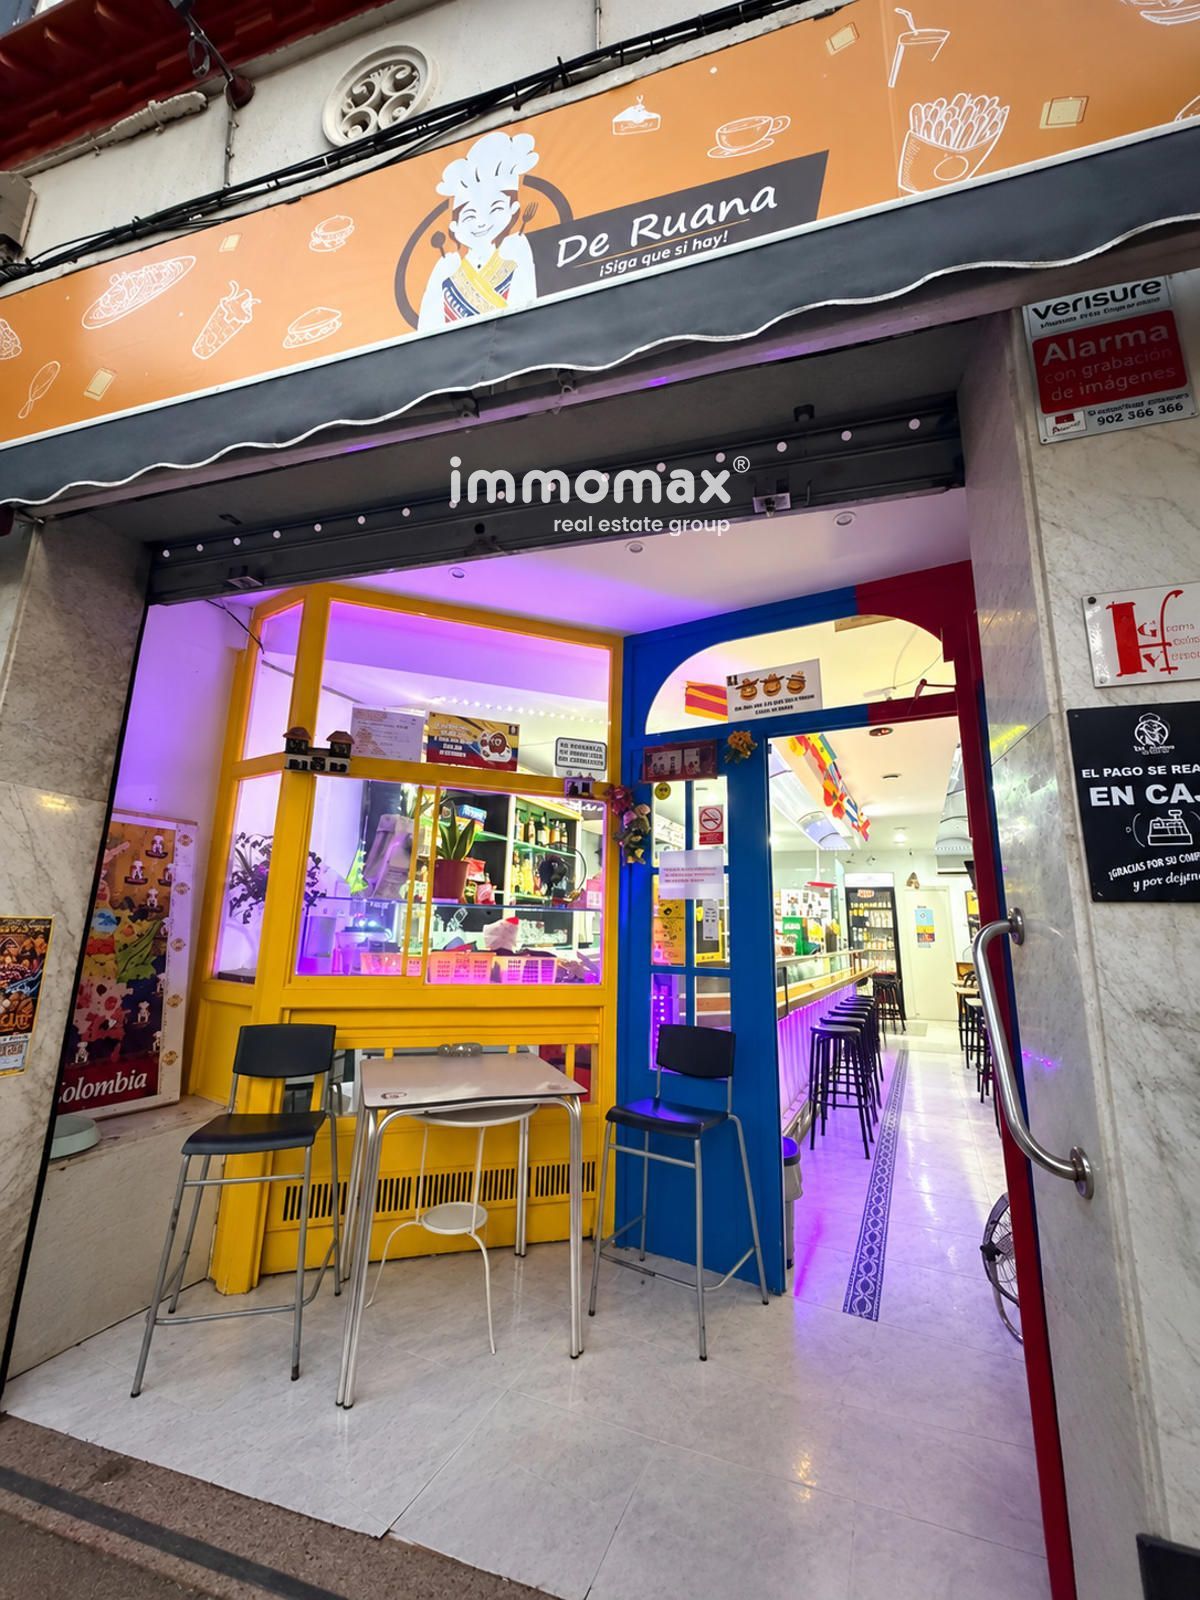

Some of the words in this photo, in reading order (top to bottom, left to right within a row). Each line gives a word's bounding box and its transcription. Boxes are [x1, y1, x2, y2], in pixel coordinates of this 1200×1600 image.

[556, 231, 610, 268] De
[630, 185, 777, 247] Ruana
[599, 256, 637, 277] ¡Siga
[641, 247, 671, 267] que
[675, 242, 687, 257] si
[692, 230, 728, 254] hay!
[1042, 325, 1168, 367] Alarma
[1045, 369, 1076, 384] con
[1082, 348, 1173, 378] grabación
[1052, 386, 1073, 401] de
[1079, 367, 1176, 395] imágenes
[1097, 413, 1124, 426] 902
[1128, 407, 1154, 420] 366
[1158, 402, 1184, 415] 366
[1081, 769, 1099, 778] EL
[1103, 766, 1143, 777] PAGO
[1147, 765, 1167, 775] SE
[1089, 785, 1135, 807] EN
[1146, 858, 1164, 869] POR
[1165, 855, 1177, 866] SU
[1133, 881, 1140, 893] y
[1143, 877, 1163, 891] por
[59, 1069, 148, 1103] olombia
